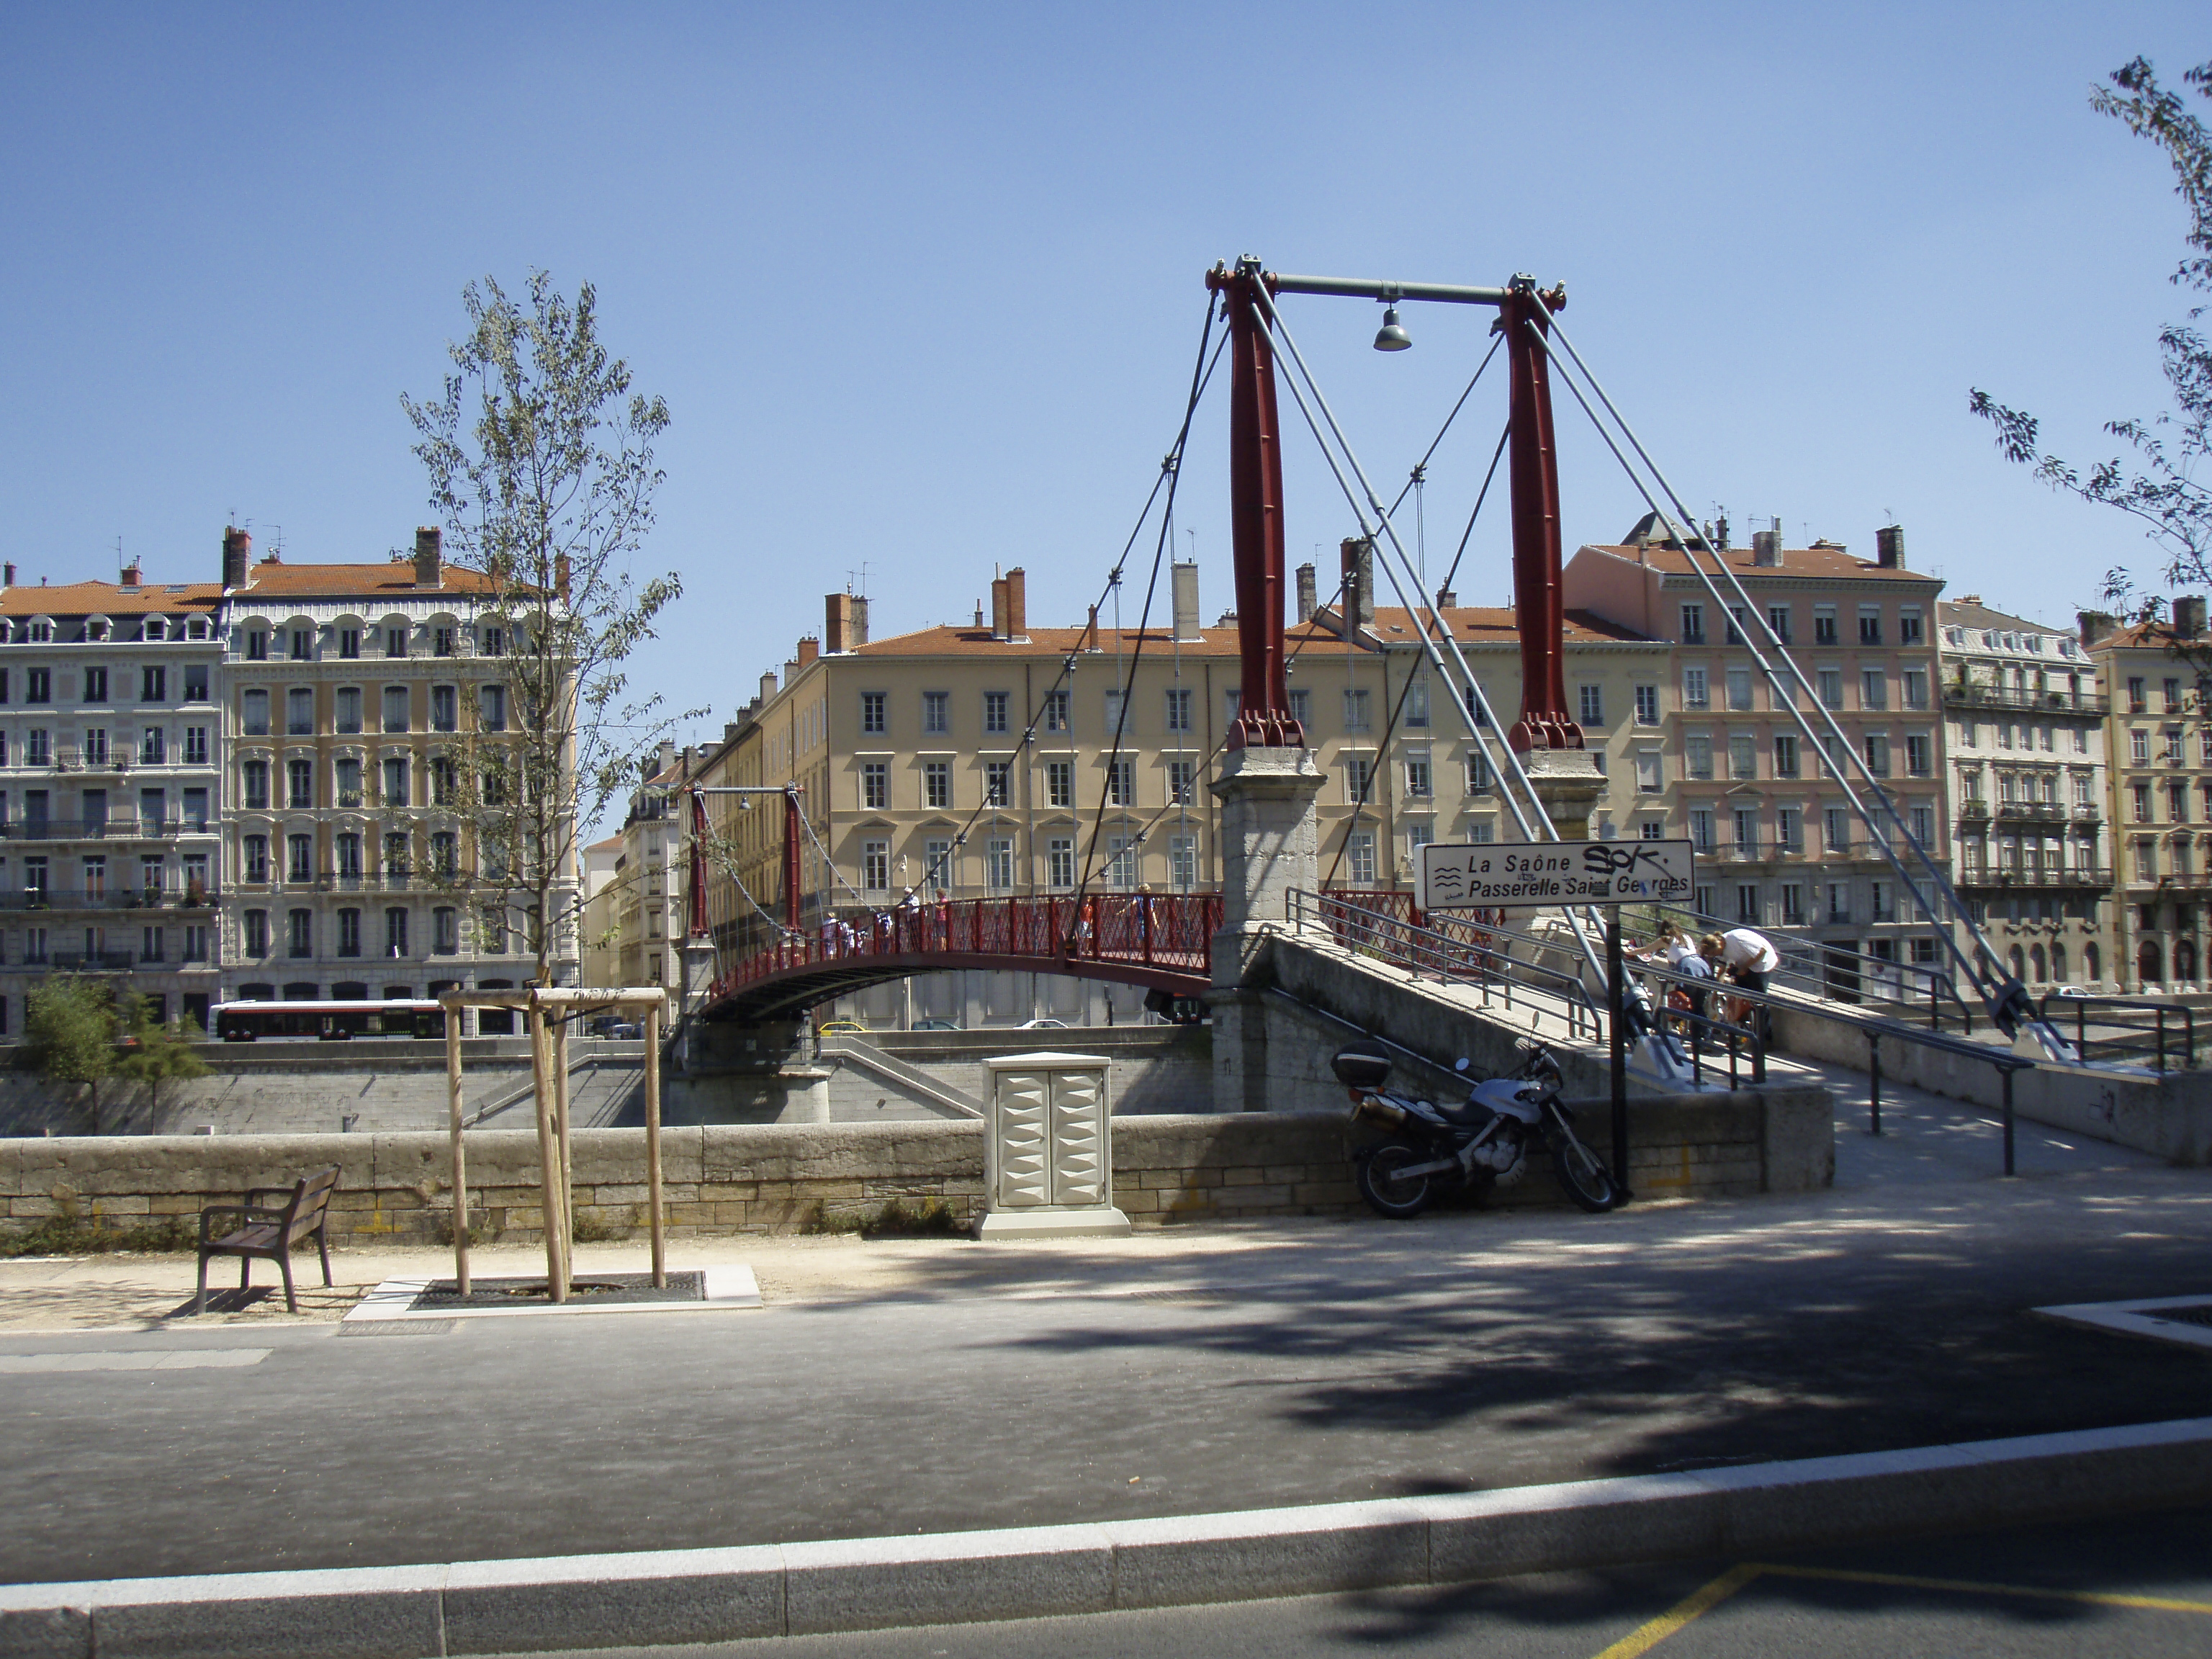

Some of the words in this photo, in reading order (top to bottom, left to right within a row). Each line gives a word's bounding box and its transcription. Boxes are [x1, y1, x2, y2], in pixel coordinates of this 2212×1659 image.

[1468, 855, 1491, 873] La
[1505, 853, 1570, 872] Saône
[1469, 878, 1560, 897] Passerelle
[1565, 877, 1611, 894] Sai
[1617, 875, 1689, 898] Gerges
